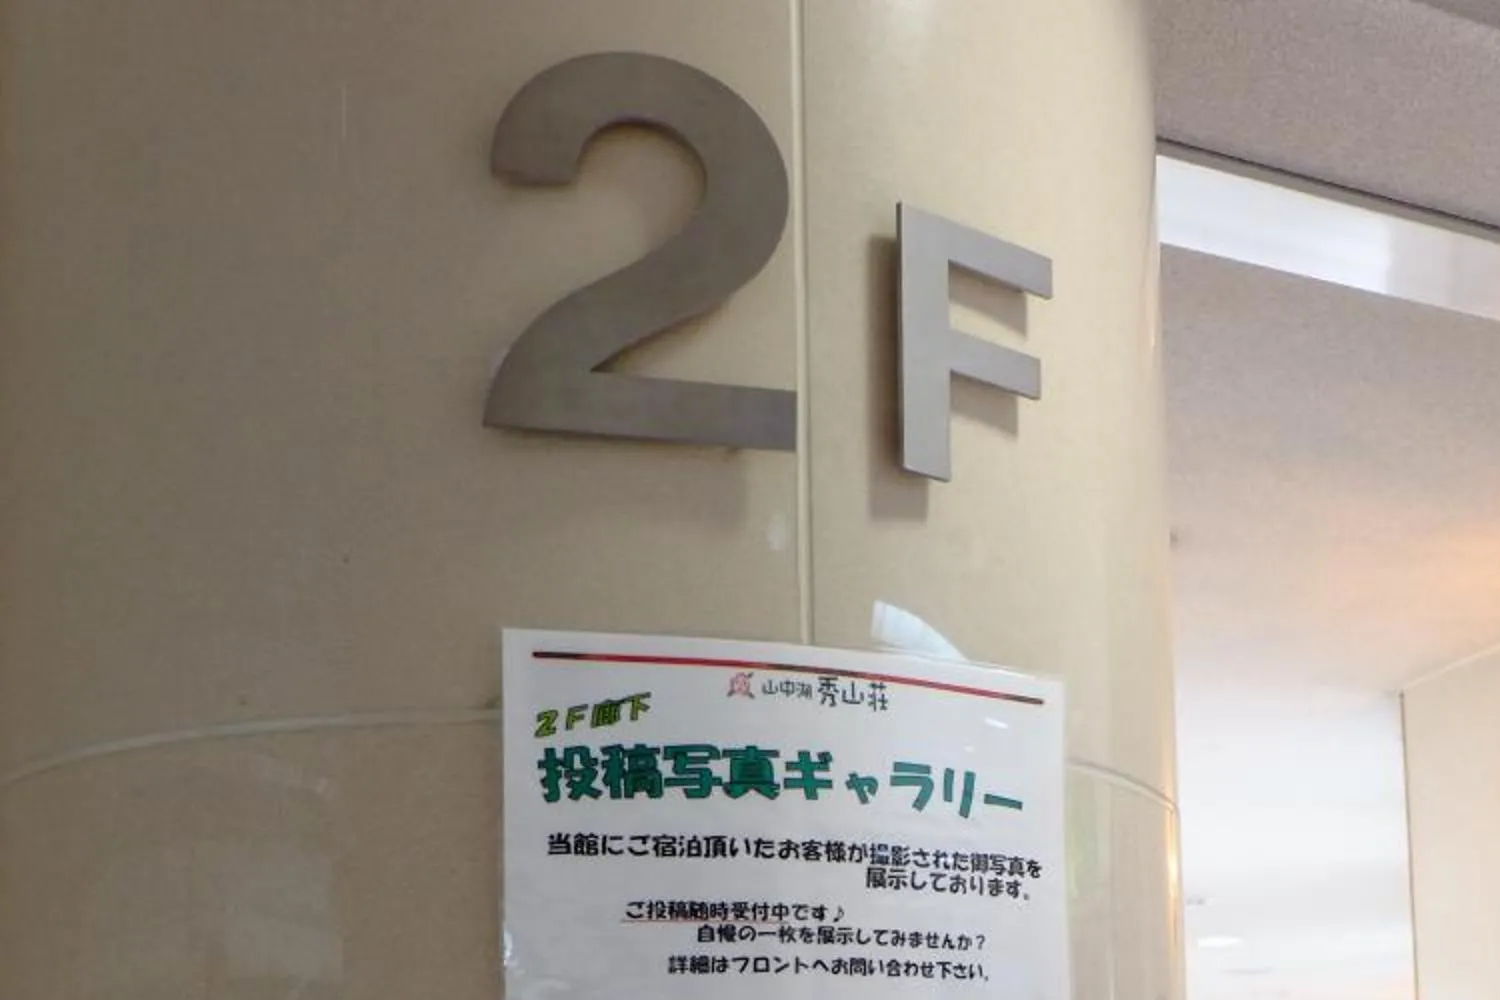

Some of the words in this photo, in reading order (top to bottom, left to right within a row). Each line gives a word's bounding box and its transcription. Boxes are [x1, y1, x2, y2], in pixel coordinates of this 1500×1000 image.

[483, 51, 1053, 483] 2F
[537, 744, 1024, 819] 投稿写真ギャラリー
[866, 867, 1030, 900] 展示しております。
